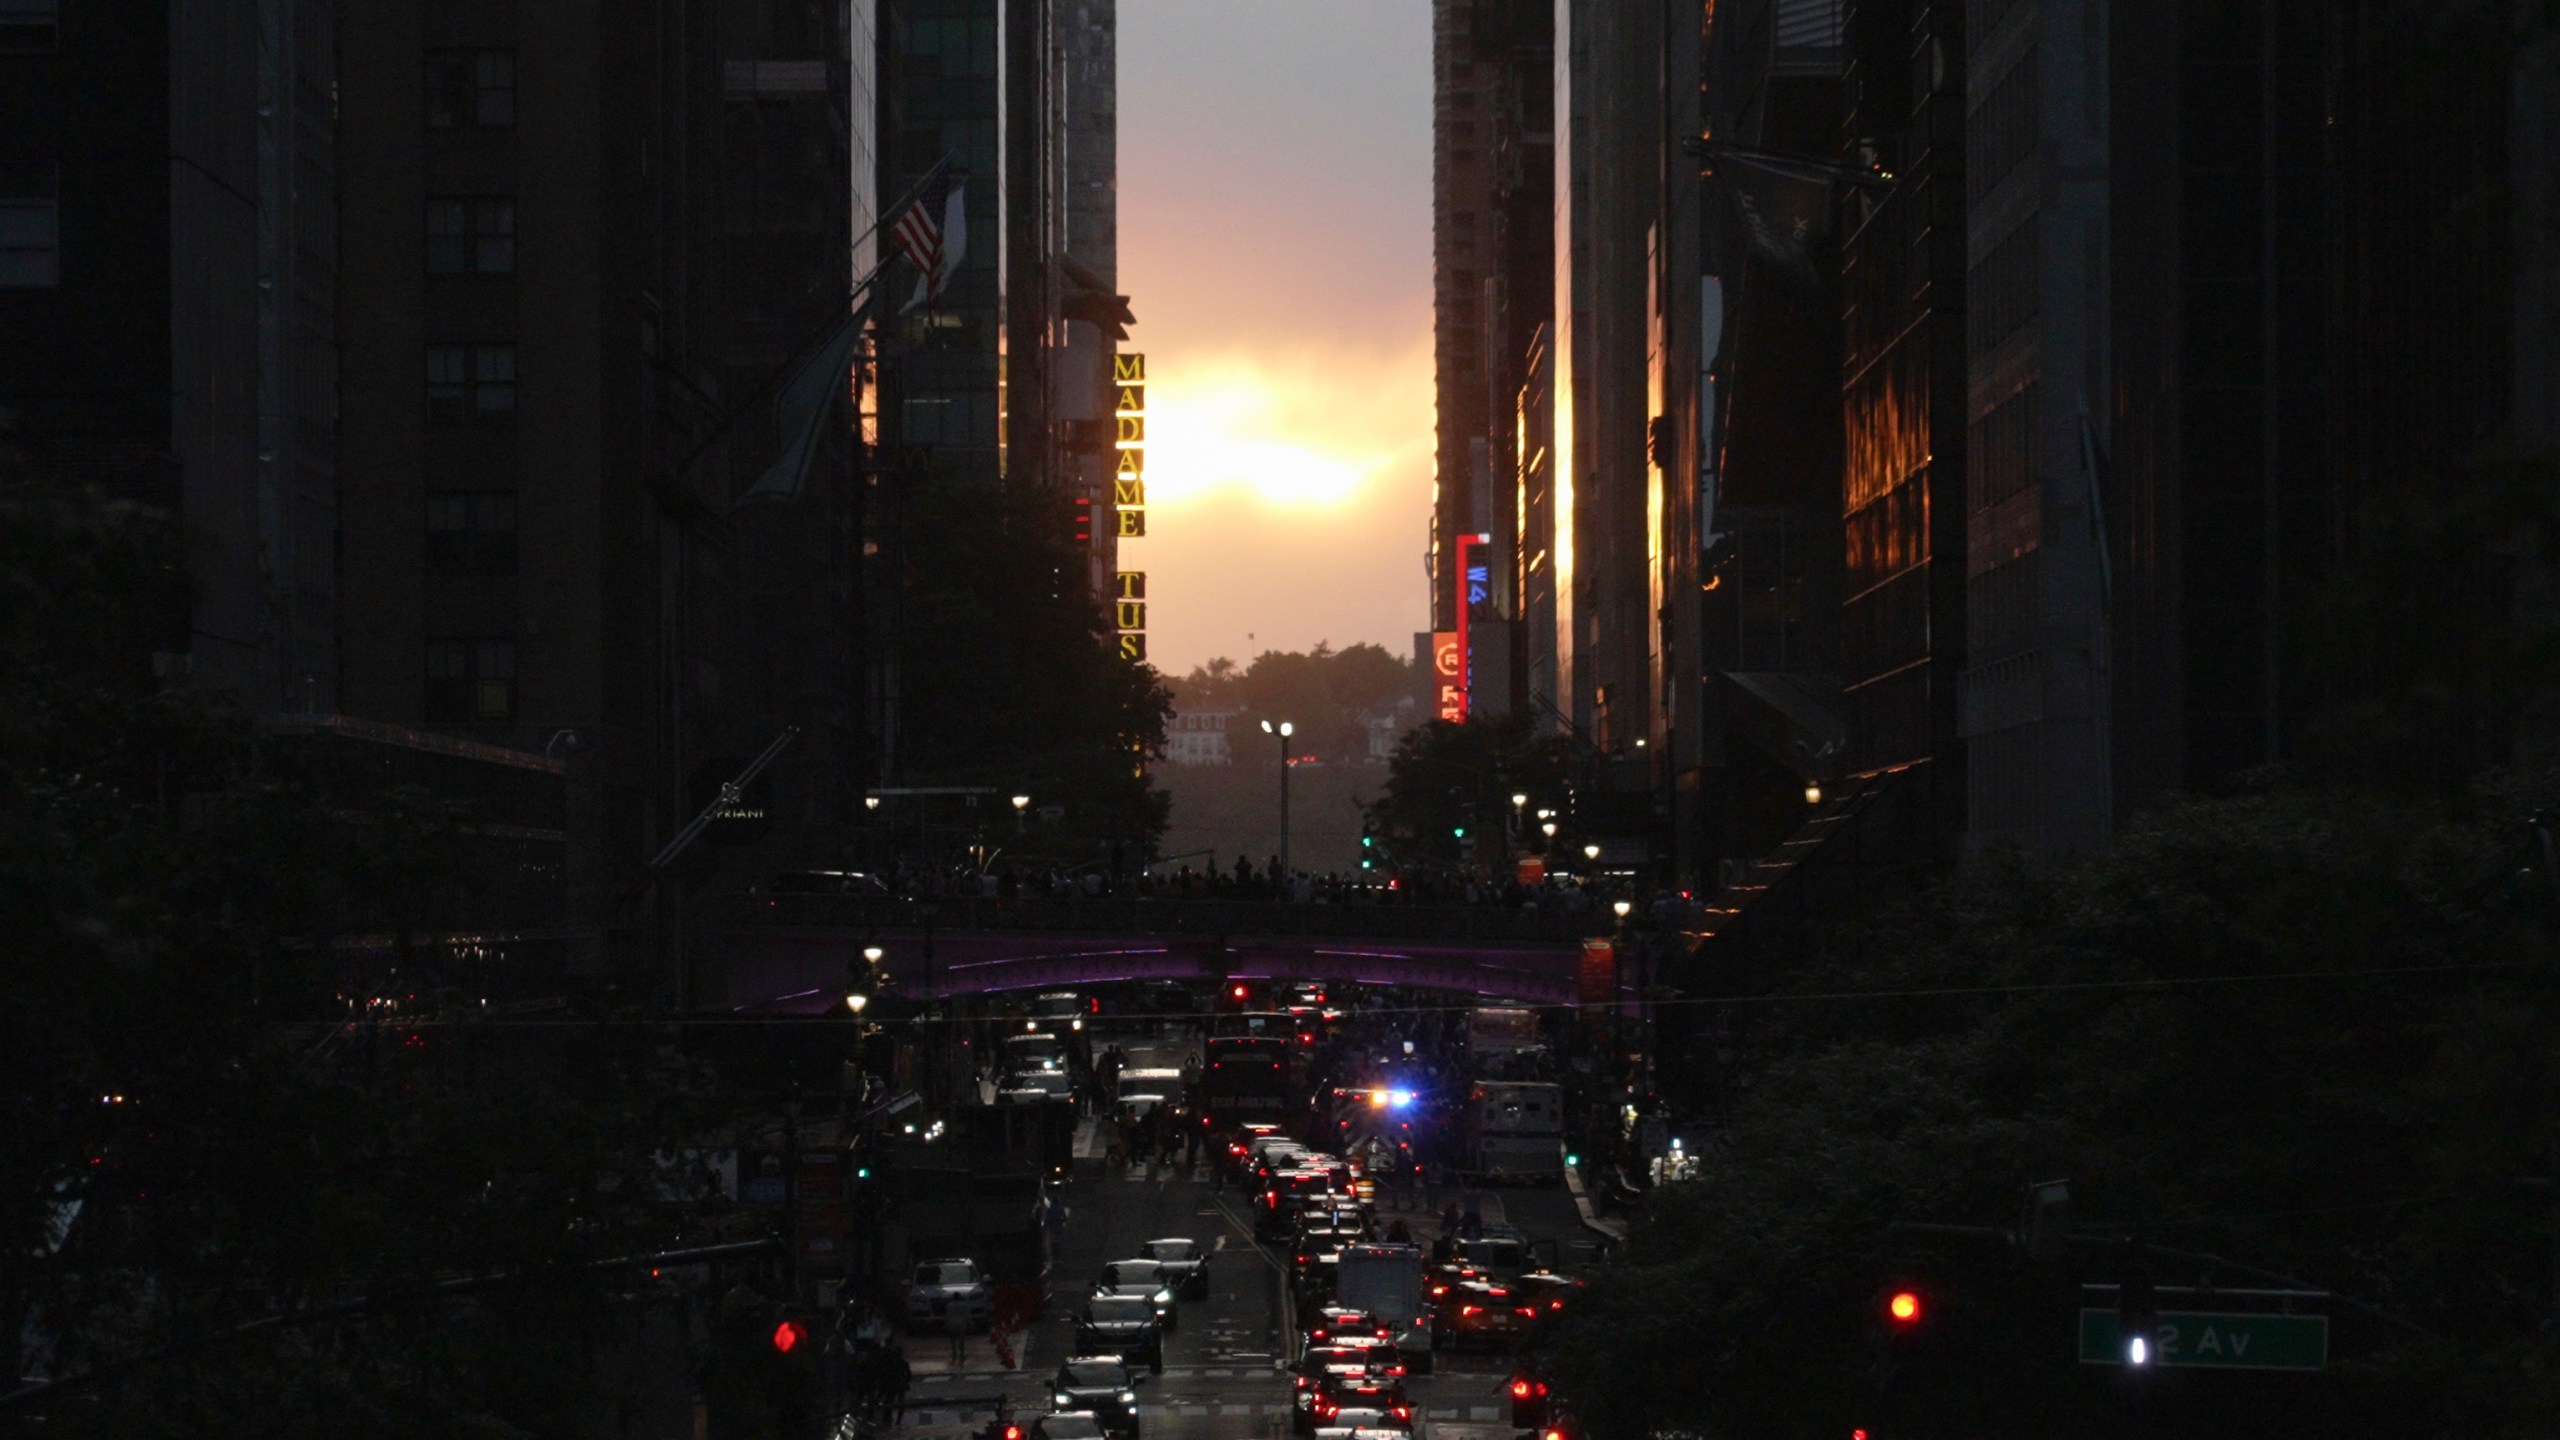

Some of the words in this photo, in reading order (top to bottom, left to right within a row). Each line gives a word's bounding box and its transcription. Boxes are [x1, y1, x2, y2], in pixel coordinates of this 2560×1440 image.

[1112, 354, 1144, 536] MADAME
[2156, 1324, 2180, 1353] 2
[2194, 1325, 2251, 1356] Av
